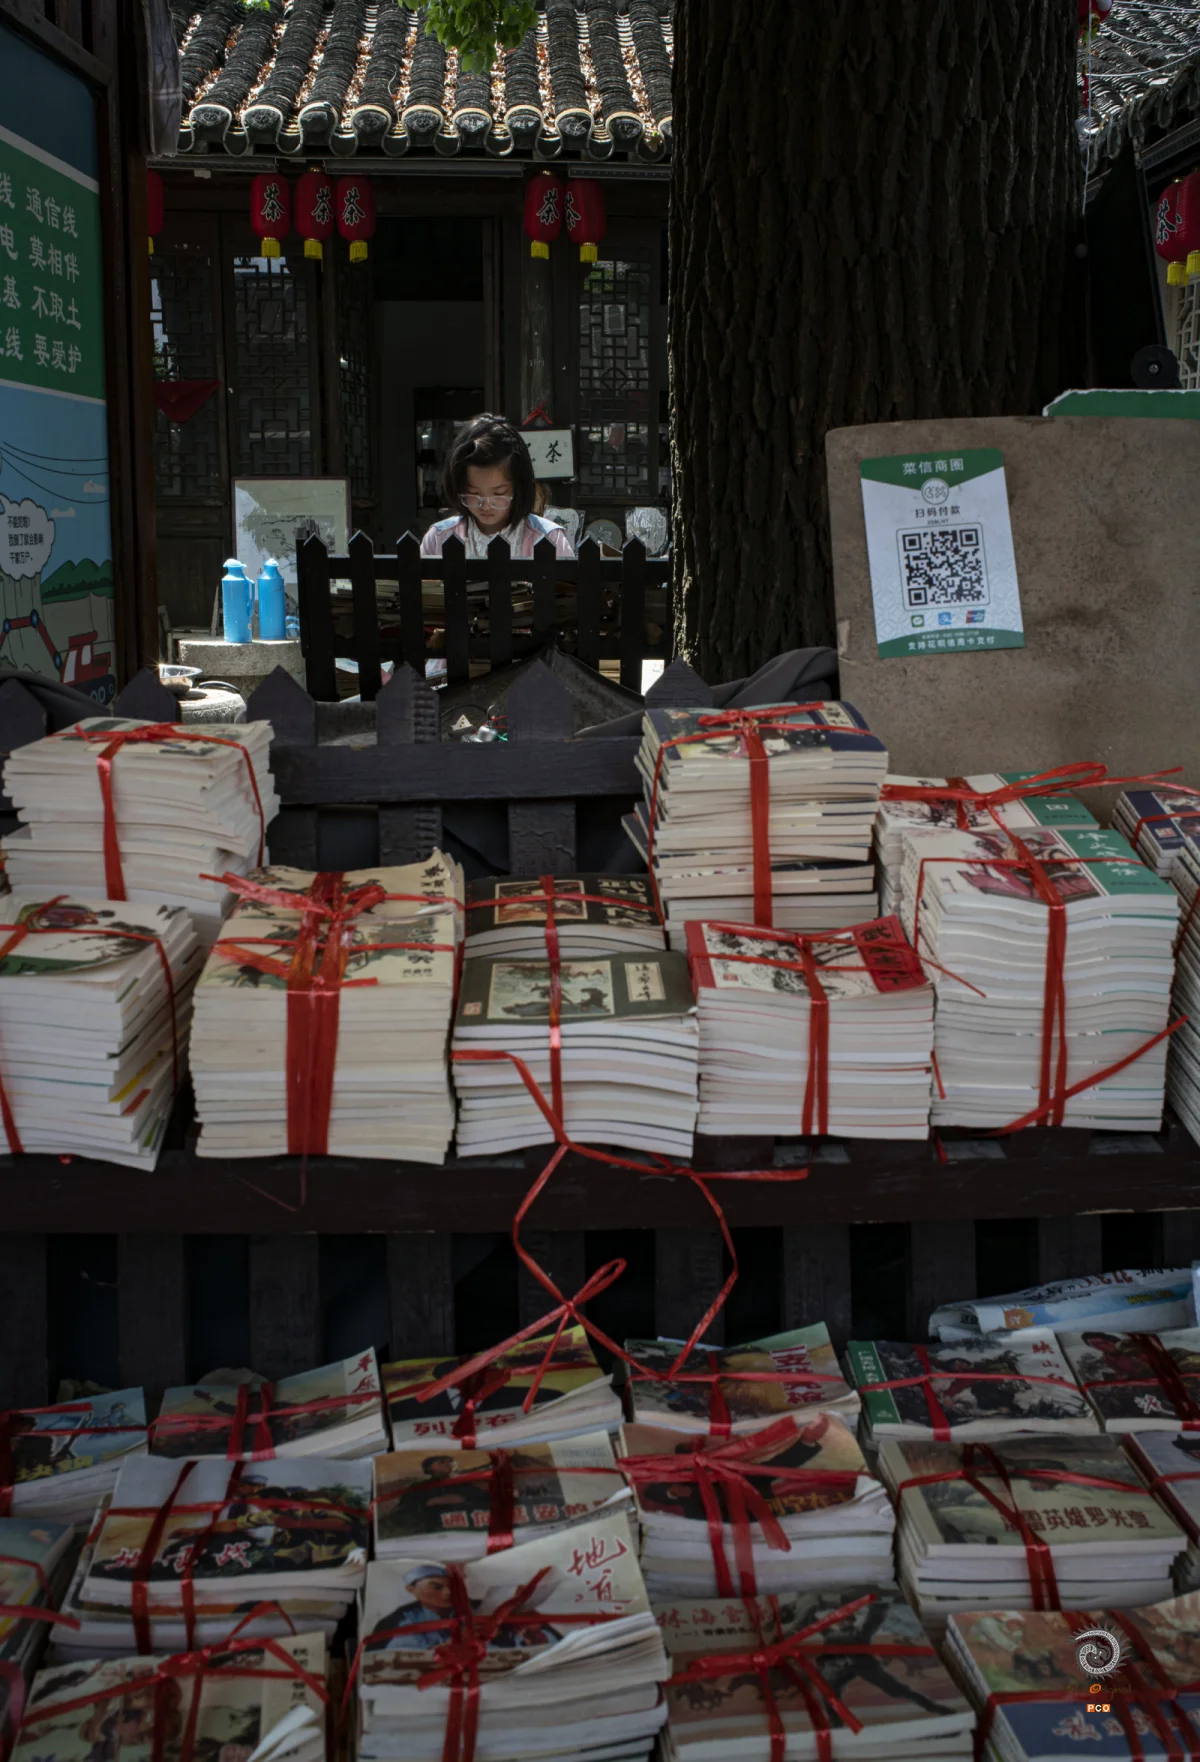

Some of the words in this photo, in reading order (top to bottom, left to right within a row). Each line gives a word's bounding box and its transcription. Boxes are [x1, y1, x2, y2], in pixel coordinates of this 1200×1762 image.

[26, 186, 78, 239] 通信线
[261, 183, 286, 222] 茶
[312, 186, 334, 225] 茶
[342, 187, 365, 226] 茶
[536, 188, 560, 225] 茶
[28, 235, 79, 283] 莫相伴
[32, 286, 81, 330] 不取土
[0, 327, 24, 361] 线
[34, 334, 81, 373] 要爱护
[546, 440, 562, 463] 茶
[915, 505, 960, 518] 扫码付款
[567, 1536, 632, 1613] 地道
[656, 1604, 771, 1629] 林海雪
